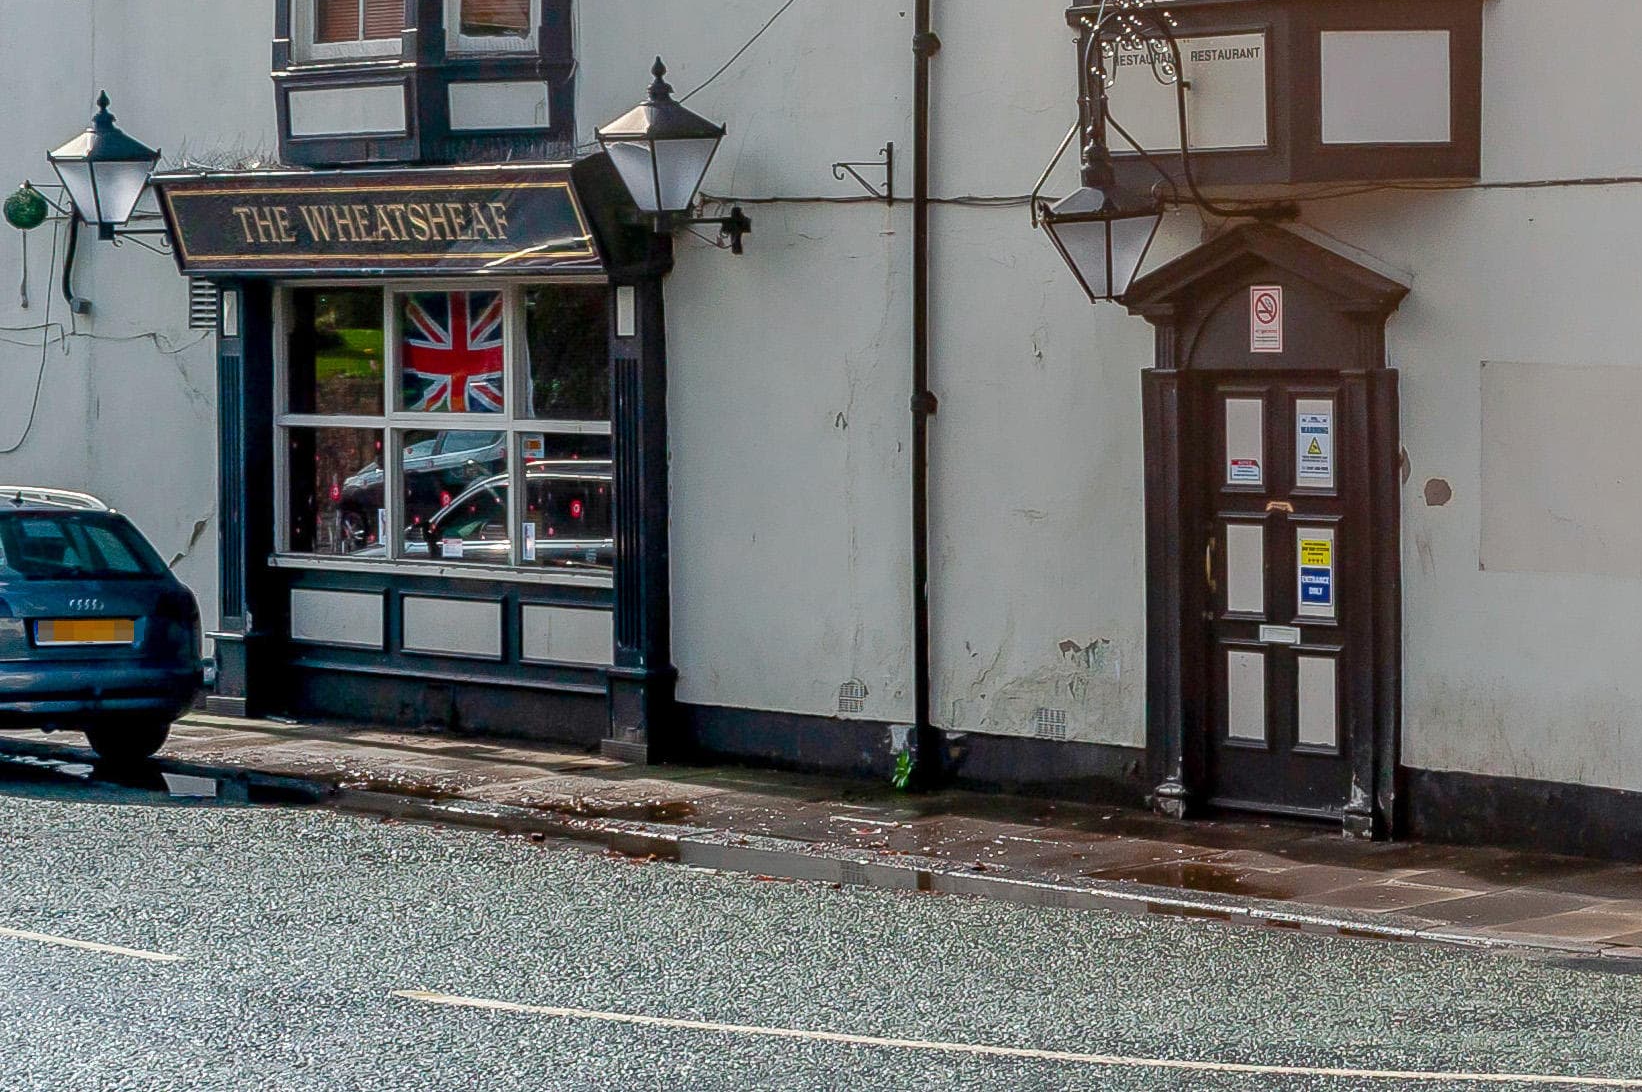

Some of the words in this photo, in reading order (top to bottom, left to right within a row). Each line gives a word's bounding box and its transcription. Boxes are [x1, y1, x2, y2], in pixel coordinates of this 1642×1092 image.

[1190, 46, 1260, 62] RESTAURANT
[232, 206, 296, 243] THE
[299, 202, 509, 242] WHEATSHEAF
